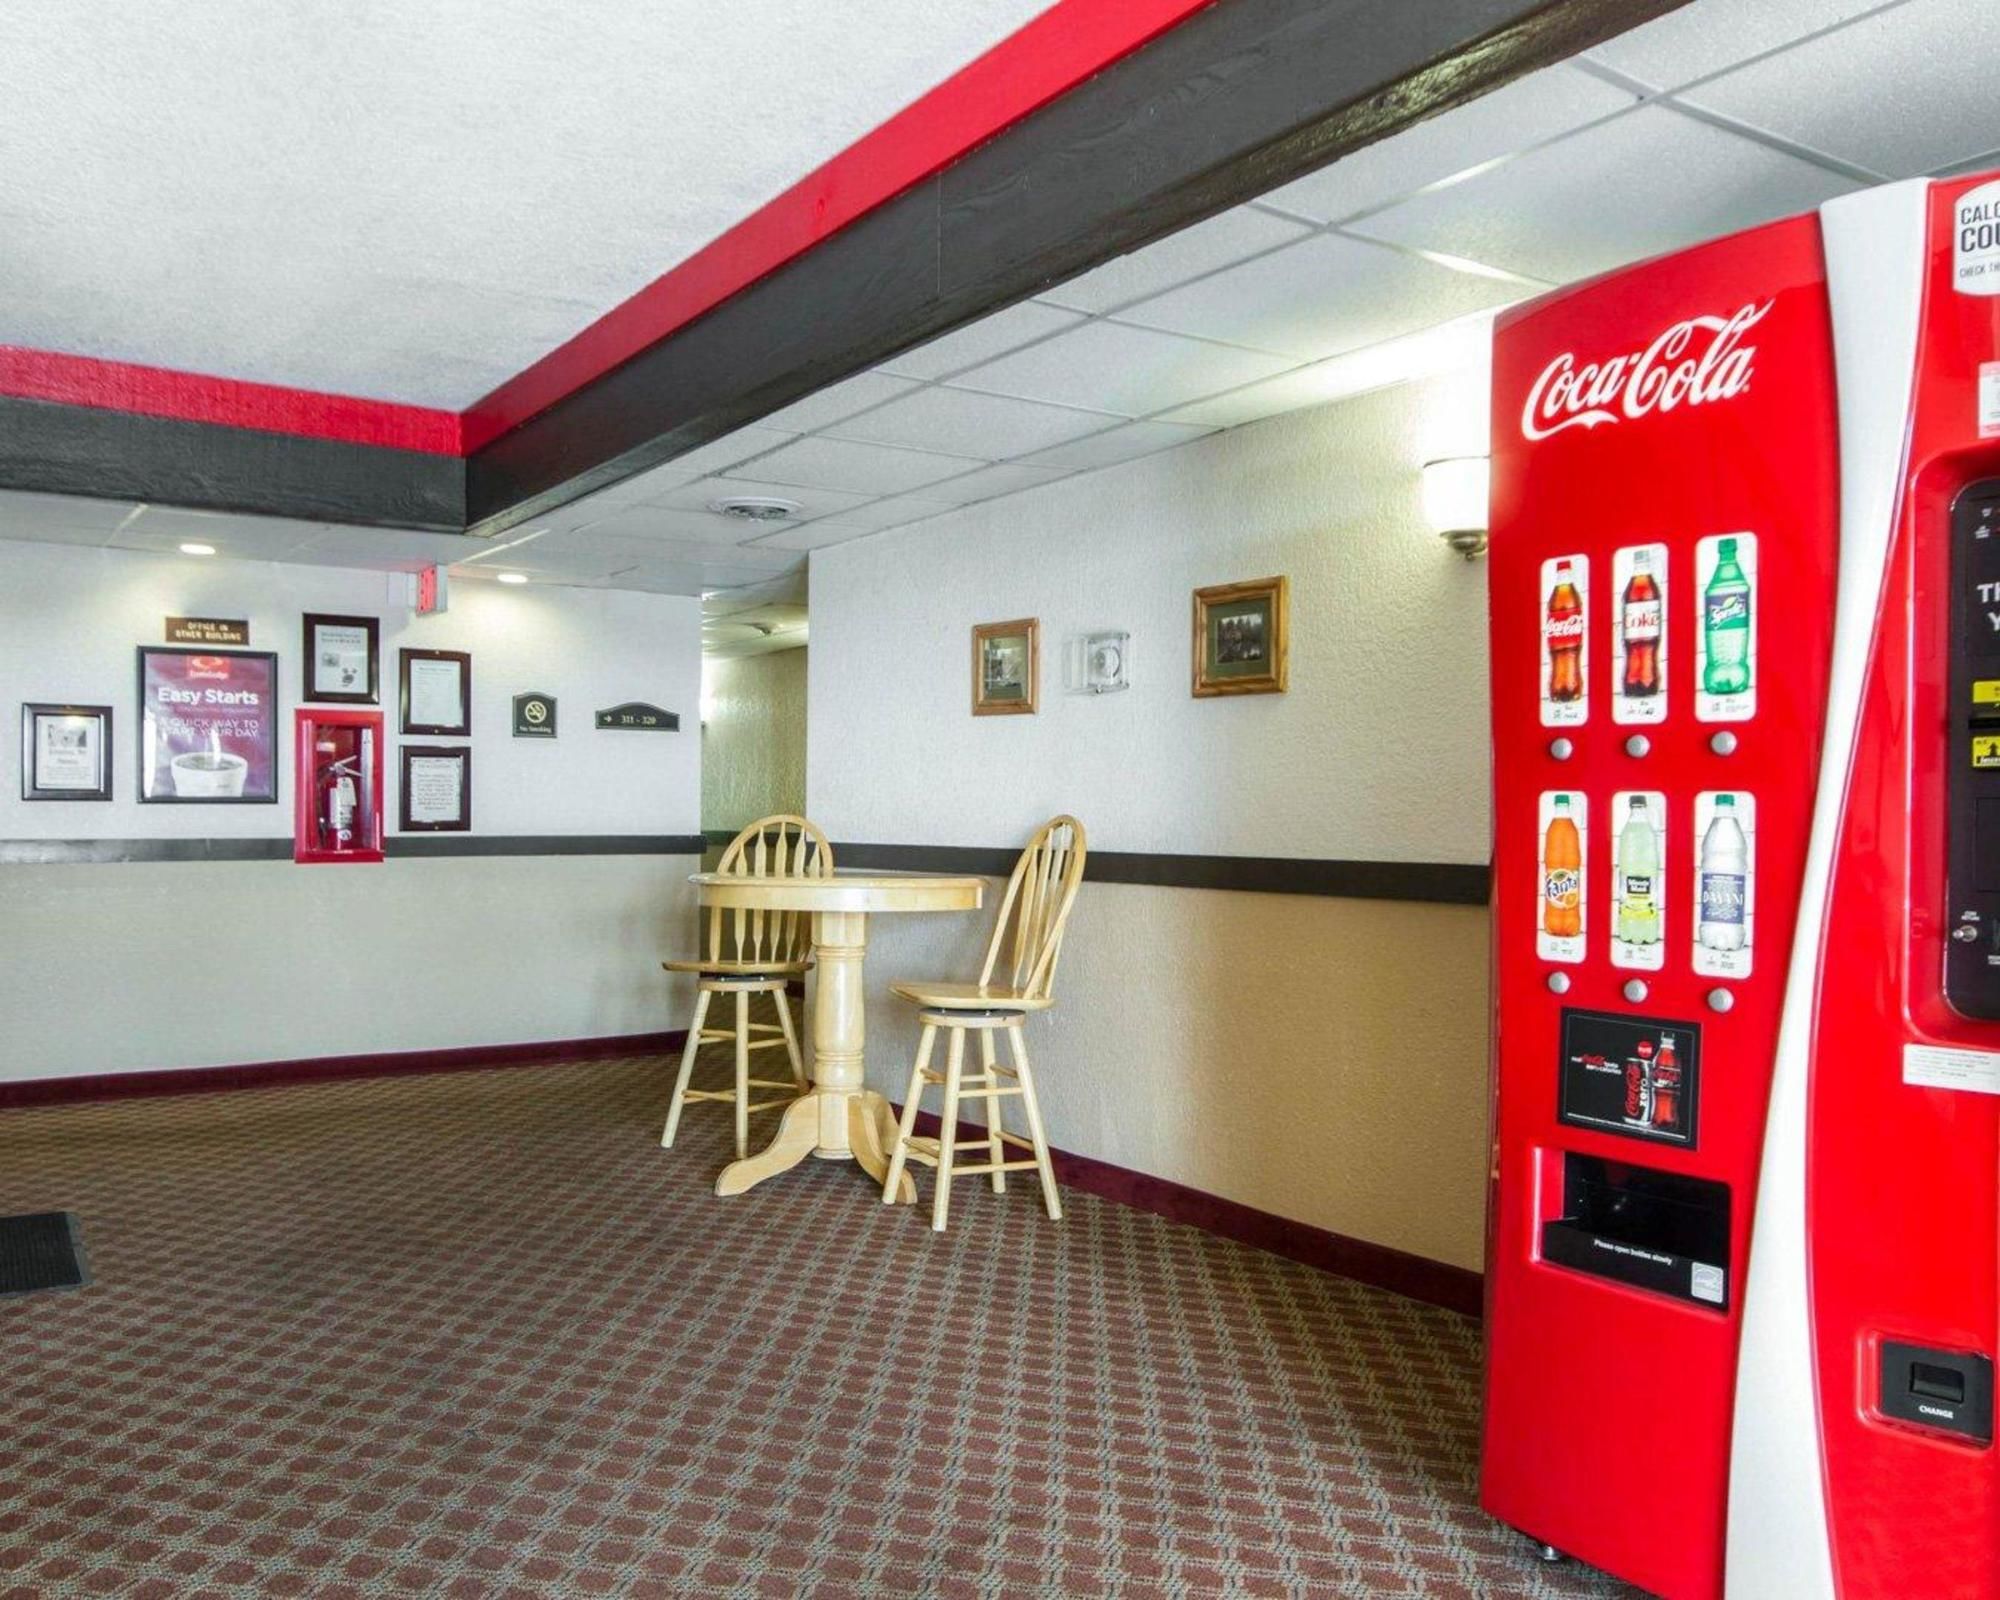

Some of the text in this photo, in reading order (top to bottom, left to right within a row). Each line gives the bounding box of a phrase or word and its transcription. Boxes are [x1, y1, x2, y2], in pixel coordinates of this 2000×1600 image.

[1521, 297, 1776, 442] Coca-Cola
[175, 629, 241, 641] OTHER BUILDING
[158, 687, 259, 705] Easy Starts
[170, 718, 209, 729] QUICK
[243, 719, 258, 729] TO
[235, 728, 258, 739] DAY
[1594, 1239, 1613, 1250] Please
[1918, 1404, 1954, 1419] CHANGE
